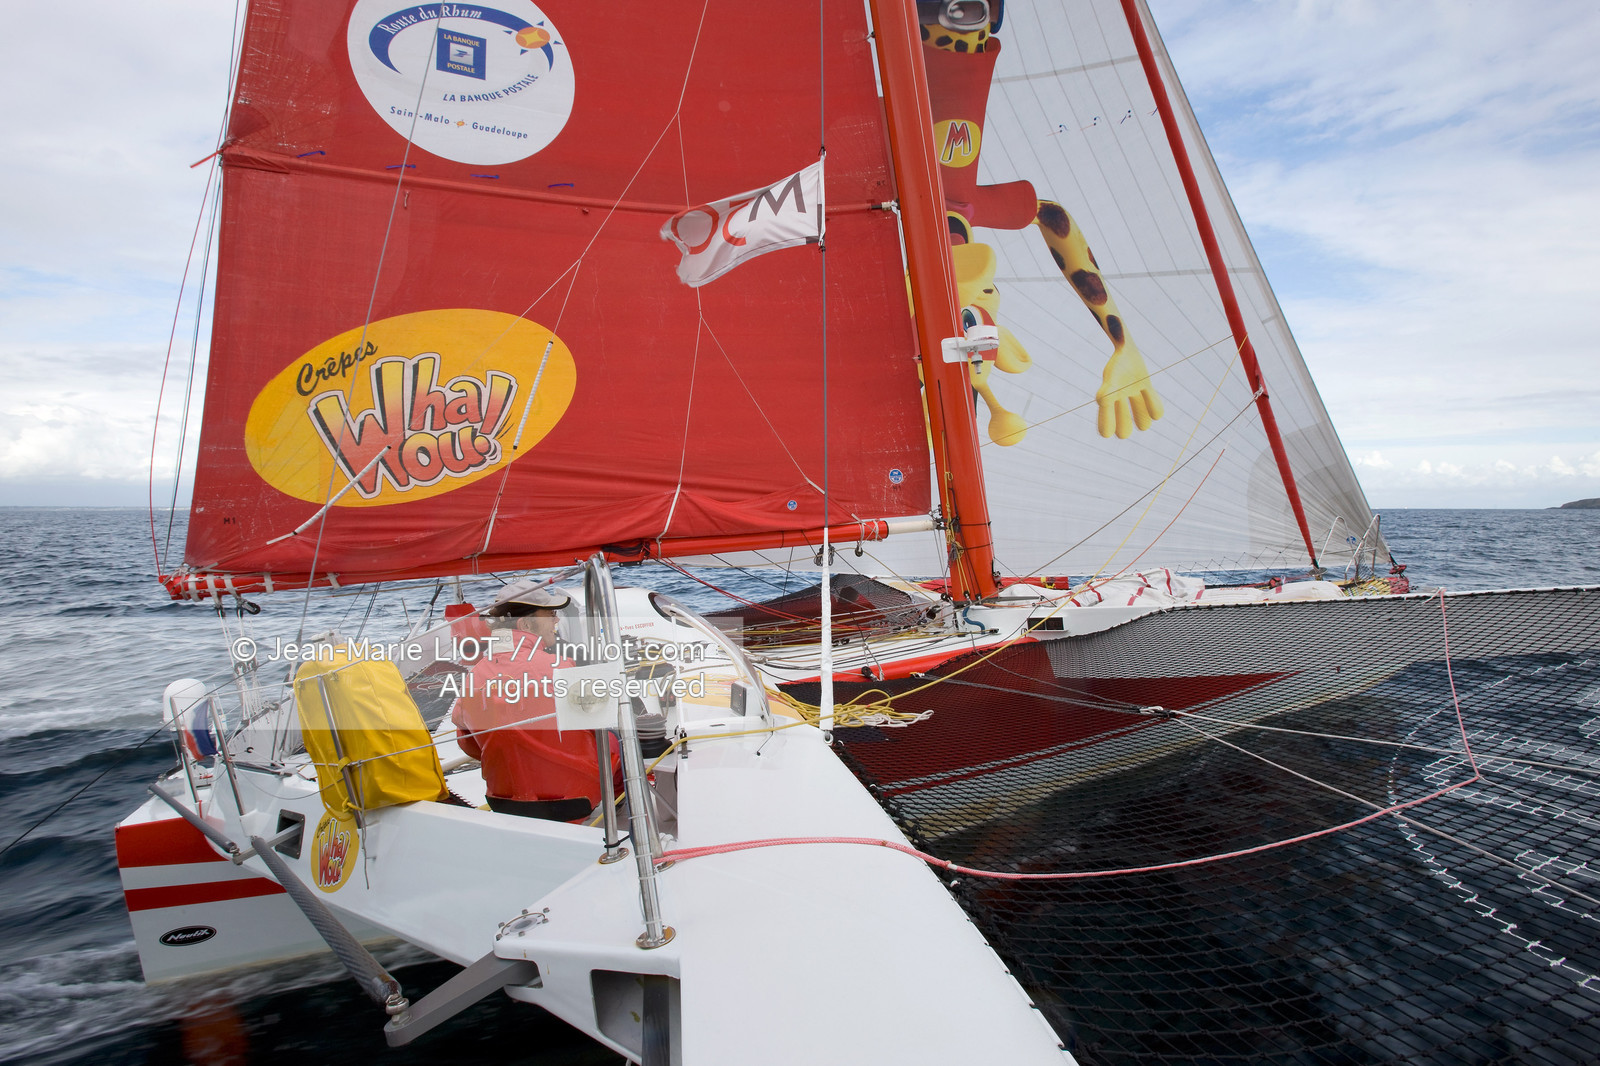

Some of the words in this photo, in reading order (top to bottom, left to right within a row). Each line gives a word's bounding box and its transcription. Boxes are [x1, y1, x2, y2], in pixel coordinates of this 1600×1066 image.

[377, 14, 417, 35] Route
[418, 7, 437, 20] du
[441, 5, 482, 18] Rhum
[452, 36, 480, 48] BANQUE
[447, 62, 476, 74] POSTALE
[443, 93, 456, 102] LA
[460, 91, 504, 103] BANQUE
[502, 73, 539, 96] POSTALE
[472, 122, 528, 139] Guadeloupe
[296, 340, 378, 397] Crêpes
